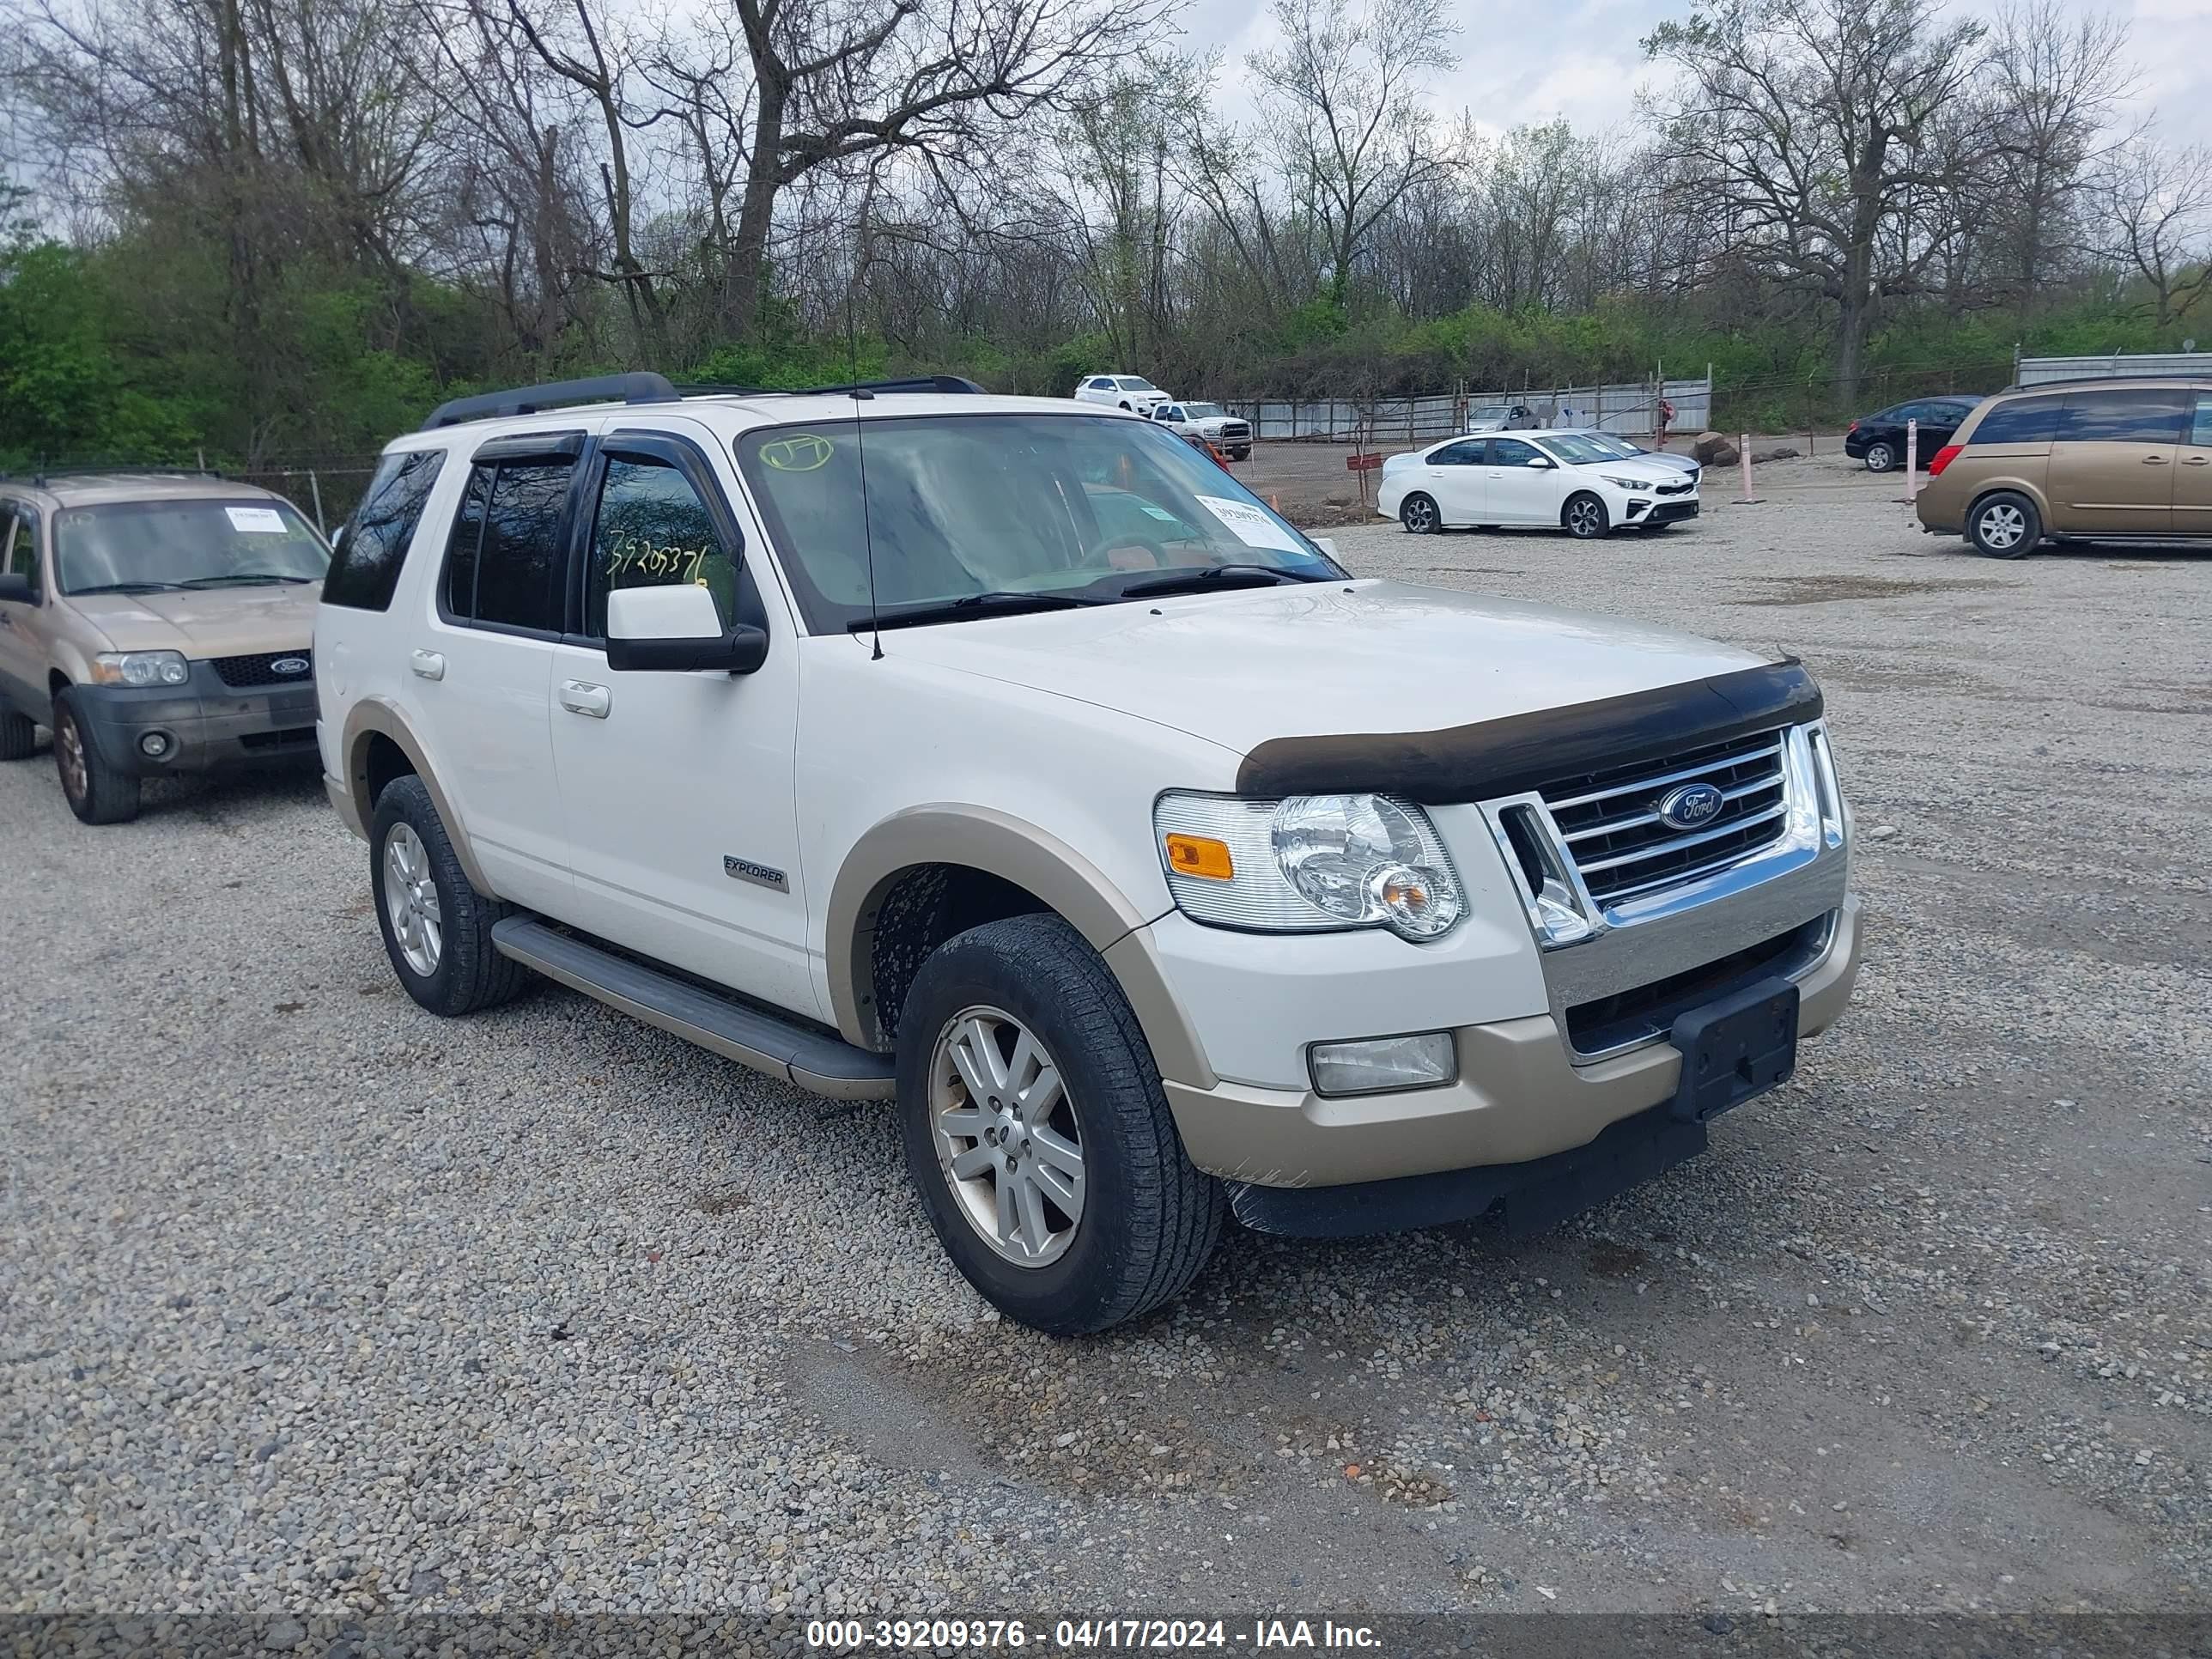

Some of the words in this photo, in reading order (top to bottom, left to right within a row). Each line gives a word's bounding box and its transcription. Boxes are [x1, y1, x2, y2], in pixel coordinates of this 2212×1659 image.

[280, 661, 301, 672] Ford
[1683, 792, 1716, 820] Ford
[725, 858, 784, 884] EXPLORER
